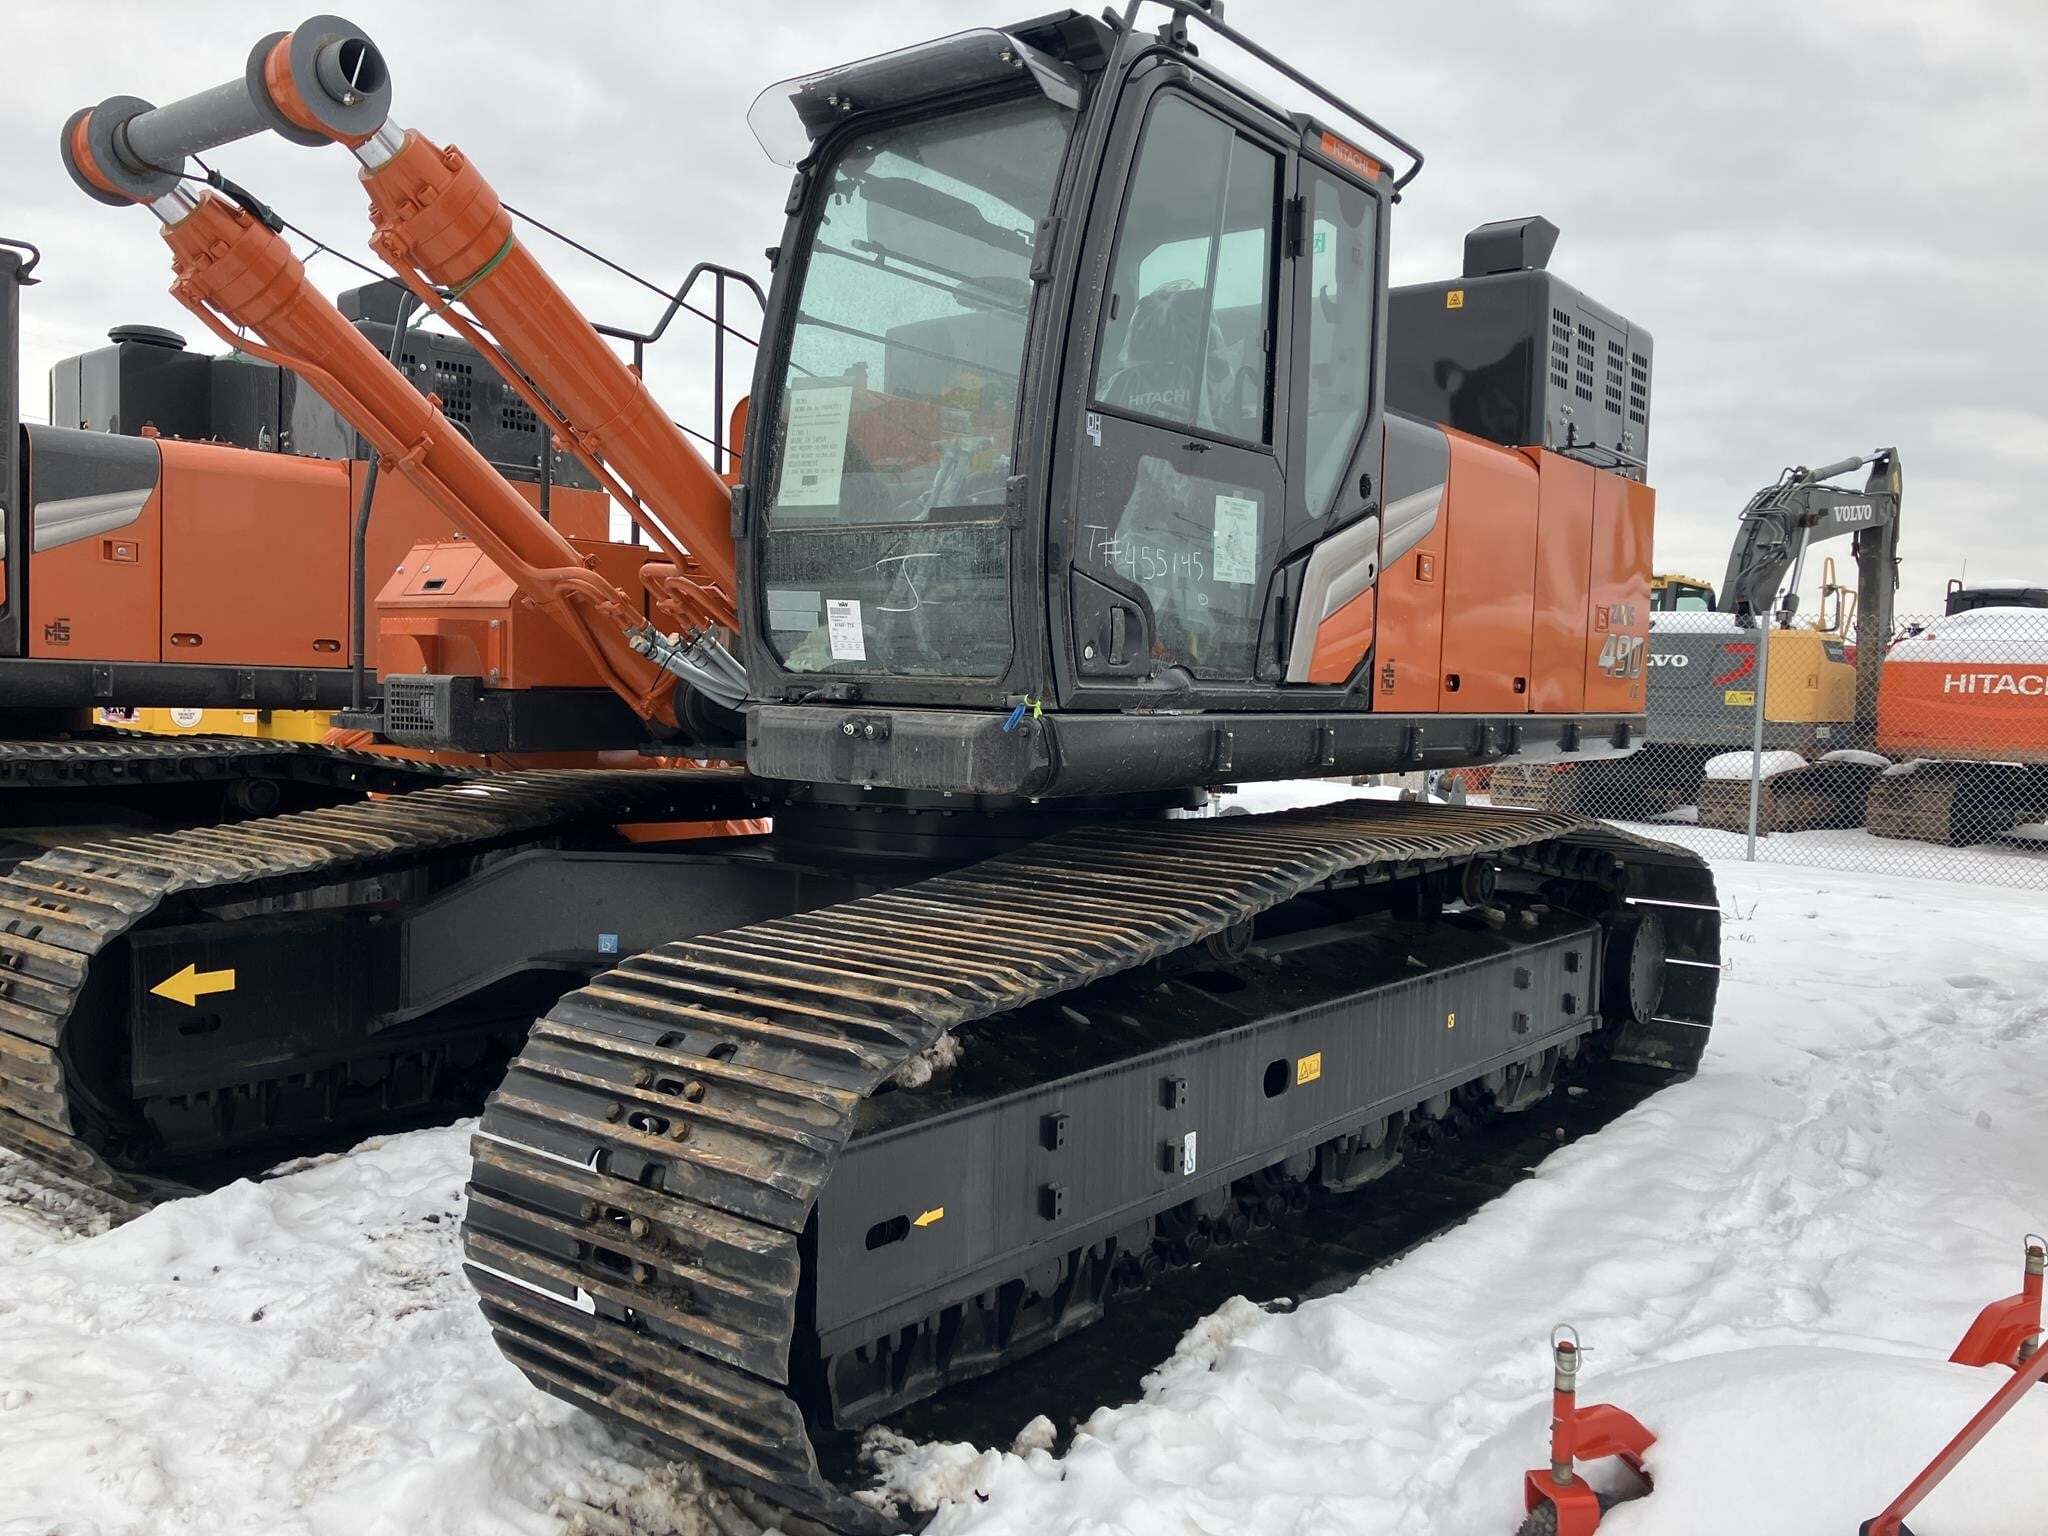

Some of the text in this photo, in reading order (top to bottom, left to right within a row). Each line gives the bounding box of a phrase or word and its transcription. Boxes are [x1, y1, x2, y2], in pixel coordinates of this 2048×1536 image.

[1332, 142, 1369, 173] HITACHI
[1128, 388, 1191, 408] HITACHI
[1833, 504, 1872, 522] VOLVO
[1598, 633, 1645, 679] 490
[1943, 673, 2048, 695] HITAC
